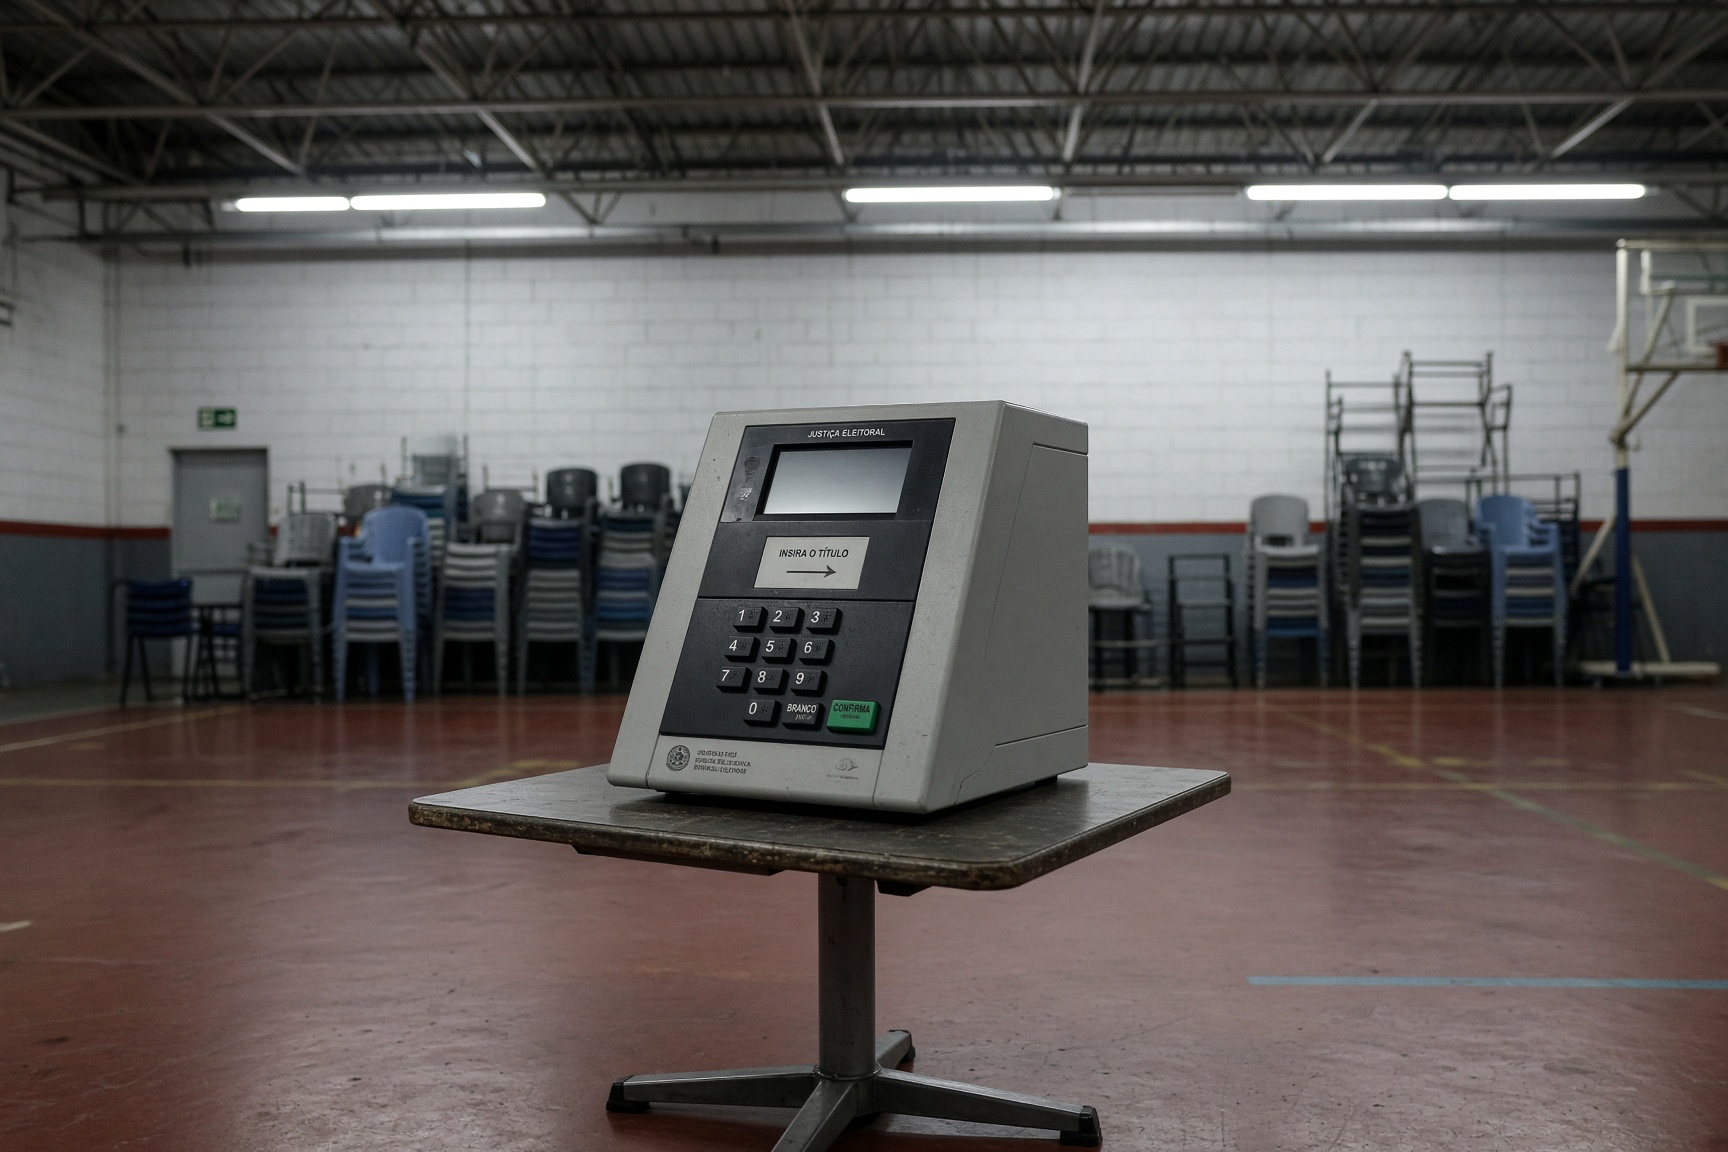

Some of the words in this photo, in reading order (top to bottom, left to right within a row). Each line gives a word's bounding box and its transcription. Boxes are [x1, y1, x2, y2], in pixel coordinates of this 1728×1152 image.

[808, 430, 840, 439] JUSTIÇA
[842, 428, 885, 437] ELEITORAL
[779, 549, 807, 558] INSIRA
[809, 549, 817, 558] O
[818, 546, 849, 558] TÍTULO
[738, 609, 745, 622] 1
[772, 610, 783, 623] 2
[810, 611, 820, 623] 3
[728, 639, 738, 652] 4
[765, 640, 775, 652] 5
[803, 641, 813, 653] 6
[721, 669, 731, 682] 7
[757, 670, 767, 683] 8
[795, 672, 805, 685] 9
[748, 702, 758, 715] 0
[786, 703, 817, 713] BRANCO
[833, 703, 870, 713] CONFIRMA
